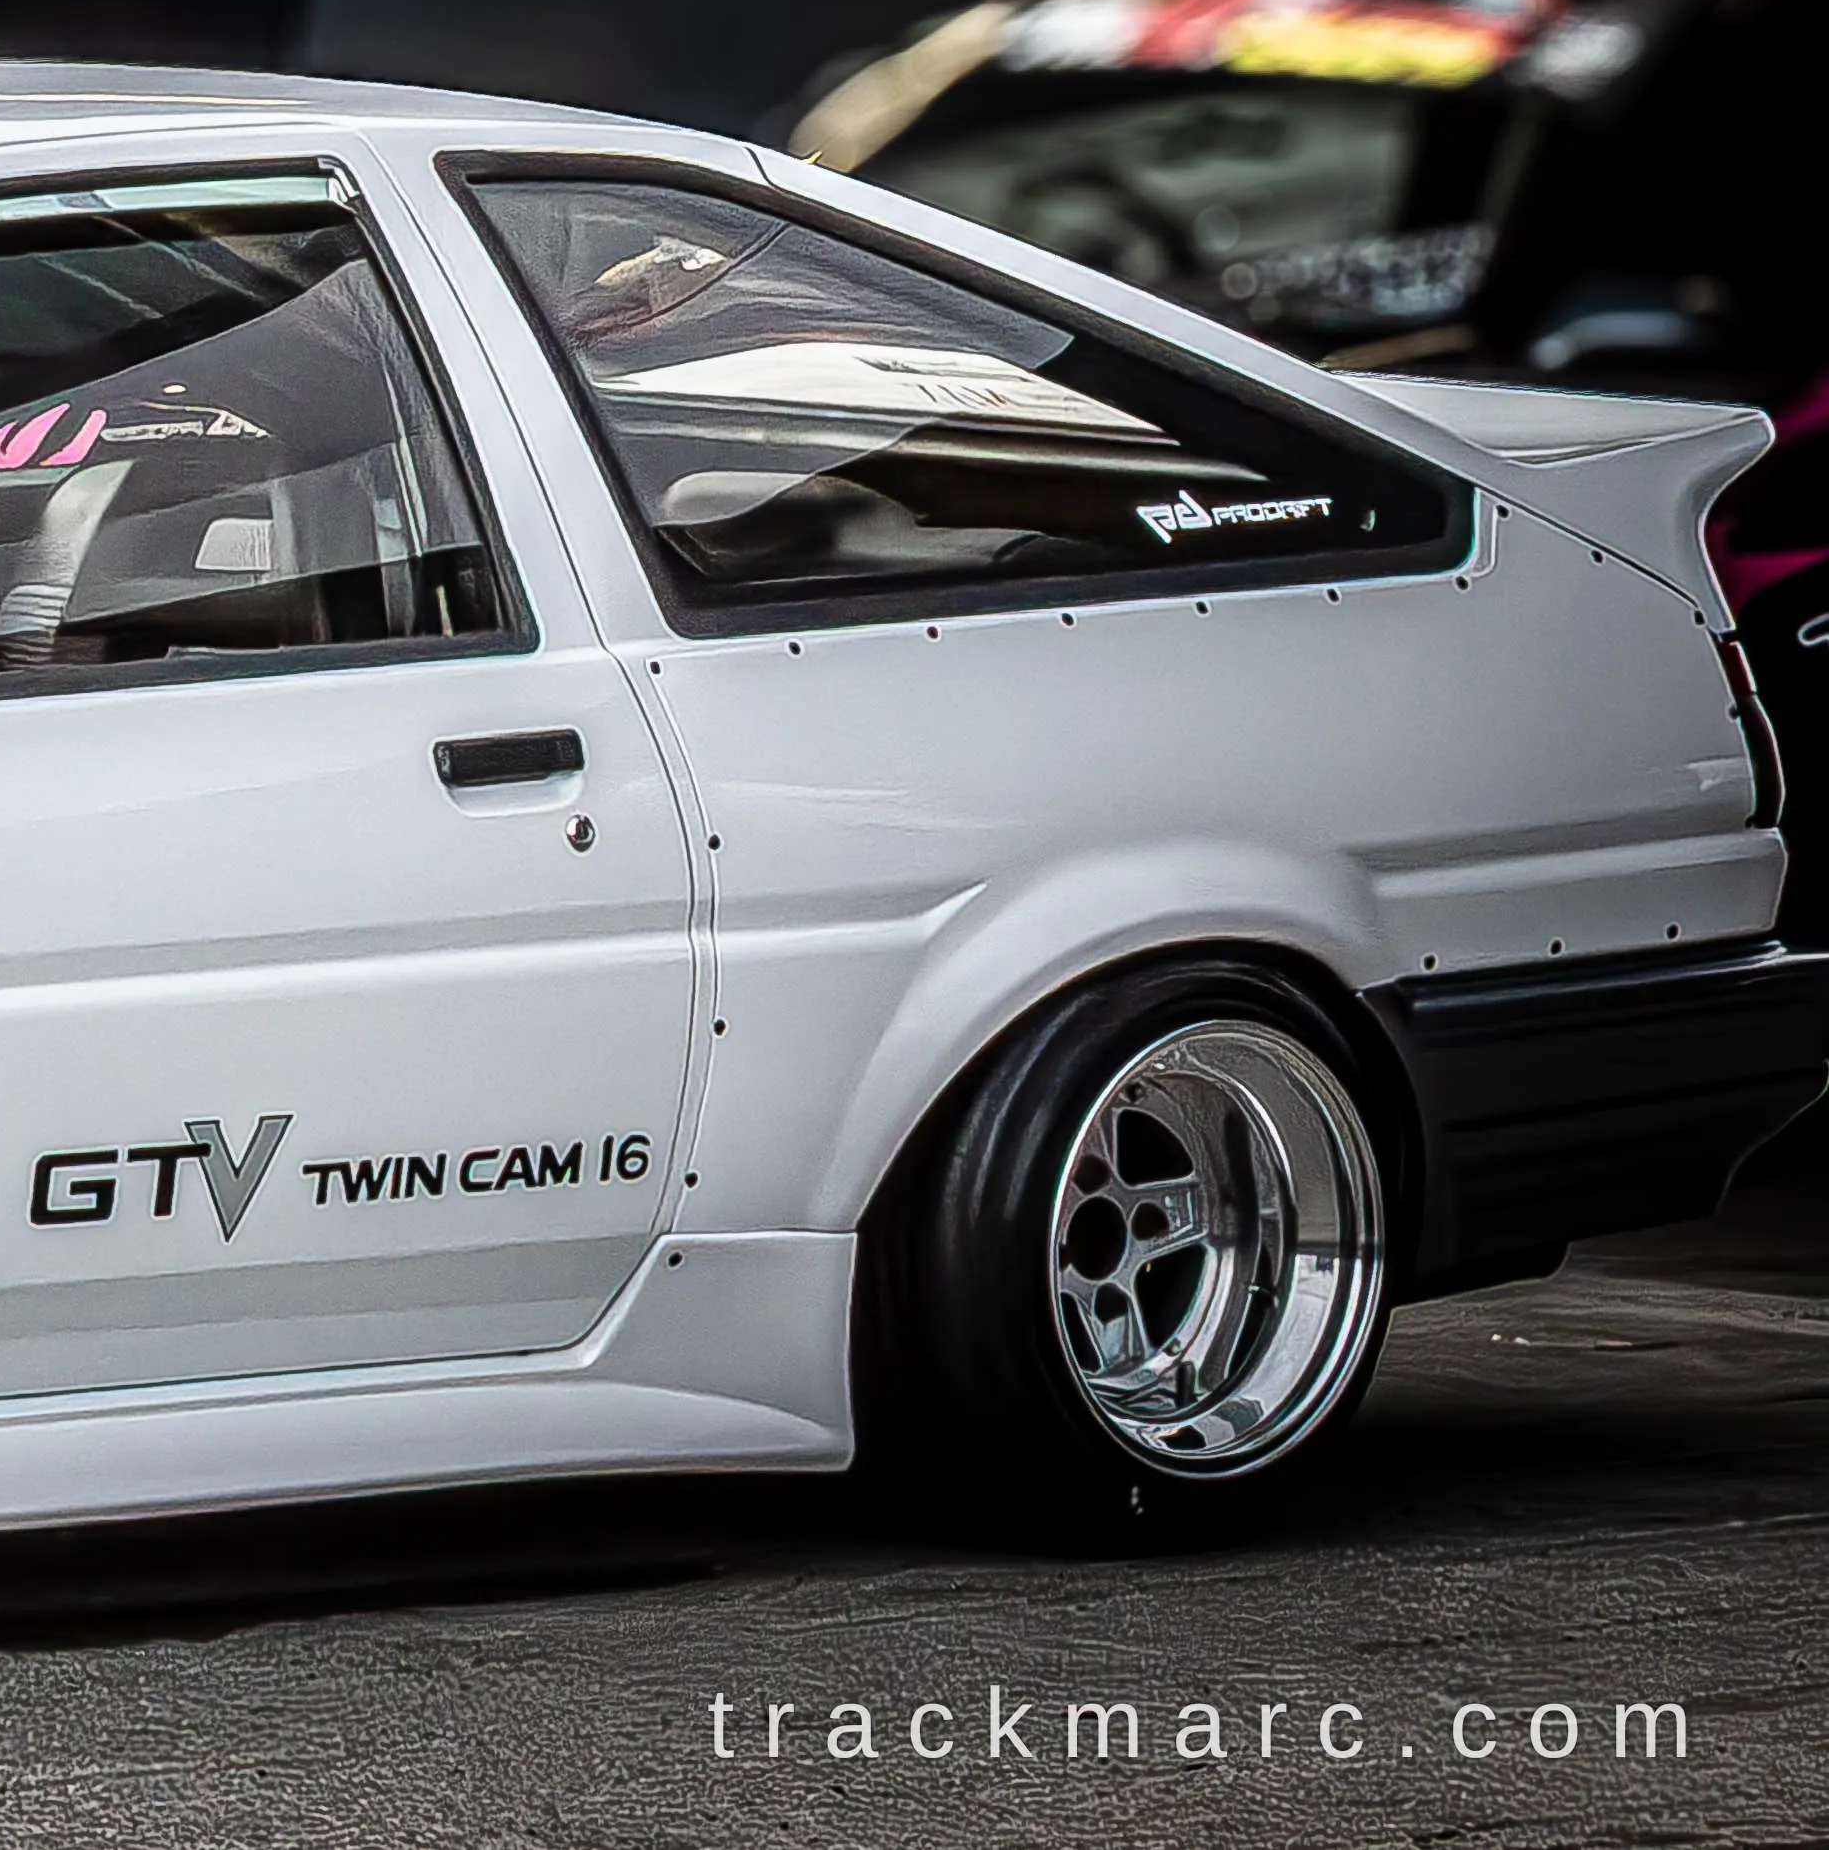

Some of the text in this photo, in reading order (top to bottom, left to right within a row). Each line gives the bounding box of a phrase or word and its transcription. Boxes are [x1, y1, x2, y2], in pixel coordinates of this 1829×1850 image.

[29, 1115, 651, 1243] GTV TWIN CAM 16
